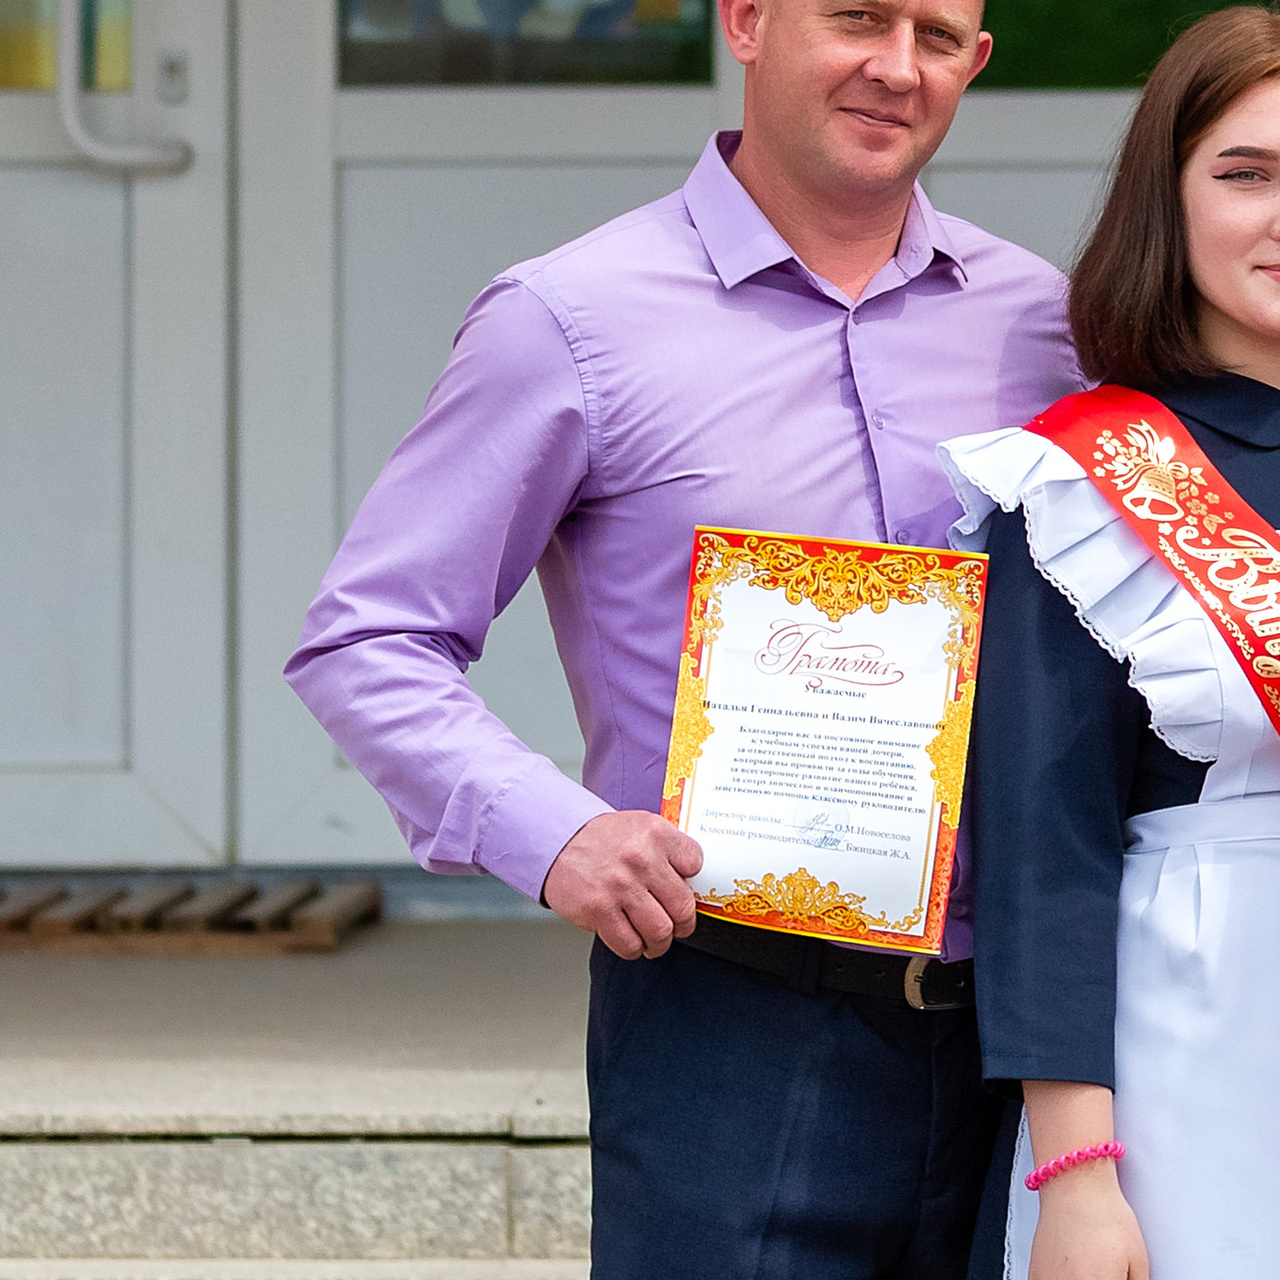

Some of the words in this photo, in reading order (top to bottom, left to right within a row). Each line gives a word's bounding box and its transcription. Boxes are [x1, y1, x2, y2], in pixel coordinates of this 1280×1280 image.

[754, 618, 904, 686] Грамота
[804, 684, 867, 699] Уважаемые
[702, 700, 748, 712] Наталья
[750, 704, 819, 719] Геннадьевна
[832, 712, 866, 723] Вадим
[869, 715, 945, 730] Вячеславович
[740, 725, 794, 738] Благодарим
[824, 735, 875, 745] постоянное
[877, 739, 922, 749] внимание
[759, 738, 799, 748] учебным
[801, 743, 838, 752] успехам
[840, 746, 868, 754] вашей
[747, 748, 815, 759] ответственный
[818, 754, 849, 764] подход
[733, 757, 773, 766] который
[790, 762, 834, 772] проявили
[847, 768, 870, 776] годы
[741, 768, 800, 778] всестороннее
[801, 773, 843, 783] развитие
[844, 778, 877, 786] вашего
[713, 785, 771, 796] действенную
[774, 791, 810, 800] помощь
[742, 777, 813, 790] сотрудничество
[823, 786, 906, 801] взаимопонимание
[701, 808, 747, 822] Директор
[699, 824, 746, 837] Классный
[845, 842, 888, 857] Бжицкая
[889, 848, 911, 860] Ж.А.
